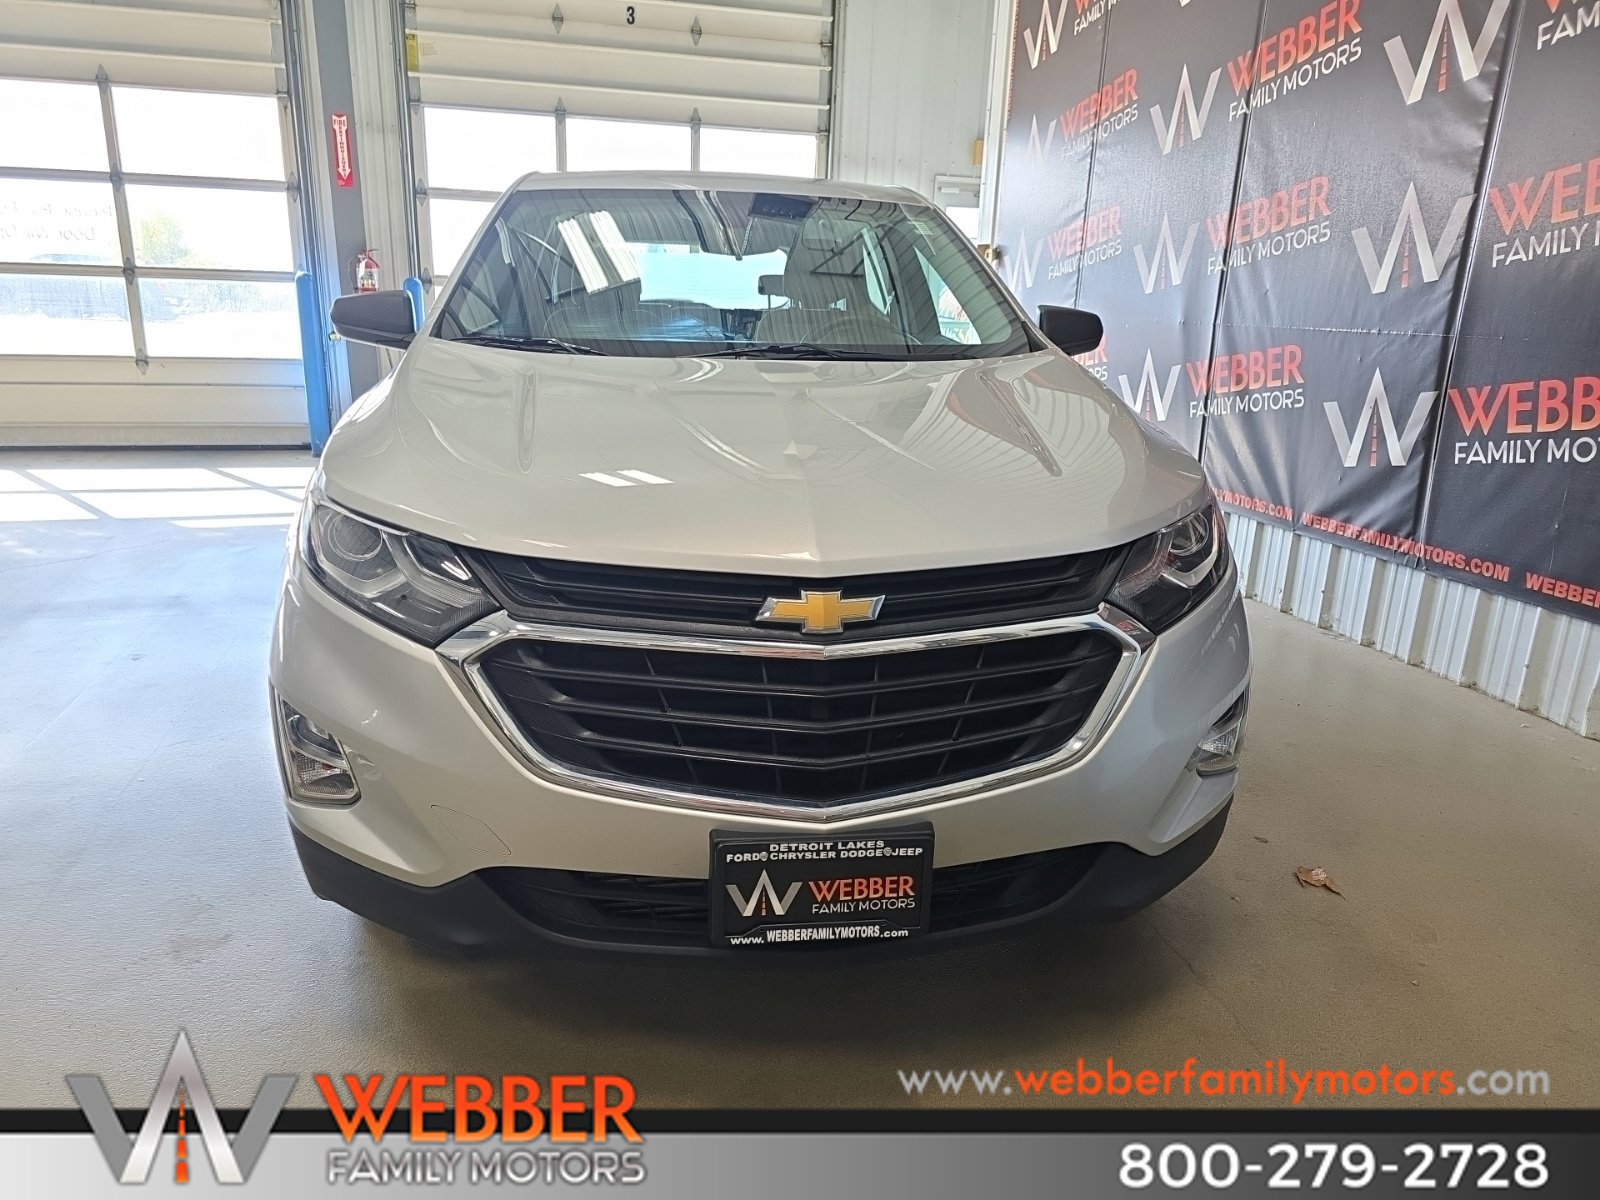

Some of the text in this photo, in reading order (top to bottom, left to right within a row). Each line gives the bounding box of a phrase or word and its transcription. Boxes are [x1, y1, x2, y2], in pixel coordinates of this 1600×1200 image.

[626, 5, 636, 26] 3
[1073, 0, 1106, 37] FAMILY
[1226, 0, 1363, 97] WEBBER
[1229, 37, 1362, 122] FAMILY MOTORS
[333, 119, 347, 127] FIRE
[1060, 68, 1140, 142] WEBBER
[1093, 103, 1139, 143] MOTORS
[1048, 204, 1123, 262] WEBBER
[1206, 175, 1332, 252] WEBBER
[1207, 220, 1331, 276] FAMILY MOTORS
[1491, 222, 1590, 268] FAMILY
[1048, 254, 1079, 281] FAMILY
[1185, 344, 1305, 398] WEBBER
[1190, 388, 1305, 419] FAMILY MOTORS
[1447, 376, 1600, 437] WEBB
[1454, 436, 1600, 465] FAMILY MO
[1300, 511, 1511, 583] WEBBERFAMILYMOTORS.COM
[726, 847, 923, 863] FORD CHRYSLER DODGE JEEP
[769, 840, 885, 852] DETROIT LAKES
[808, 875, 916, 902] WEBBER
[812, 897, 916, 915] FAMILY MOTORS
